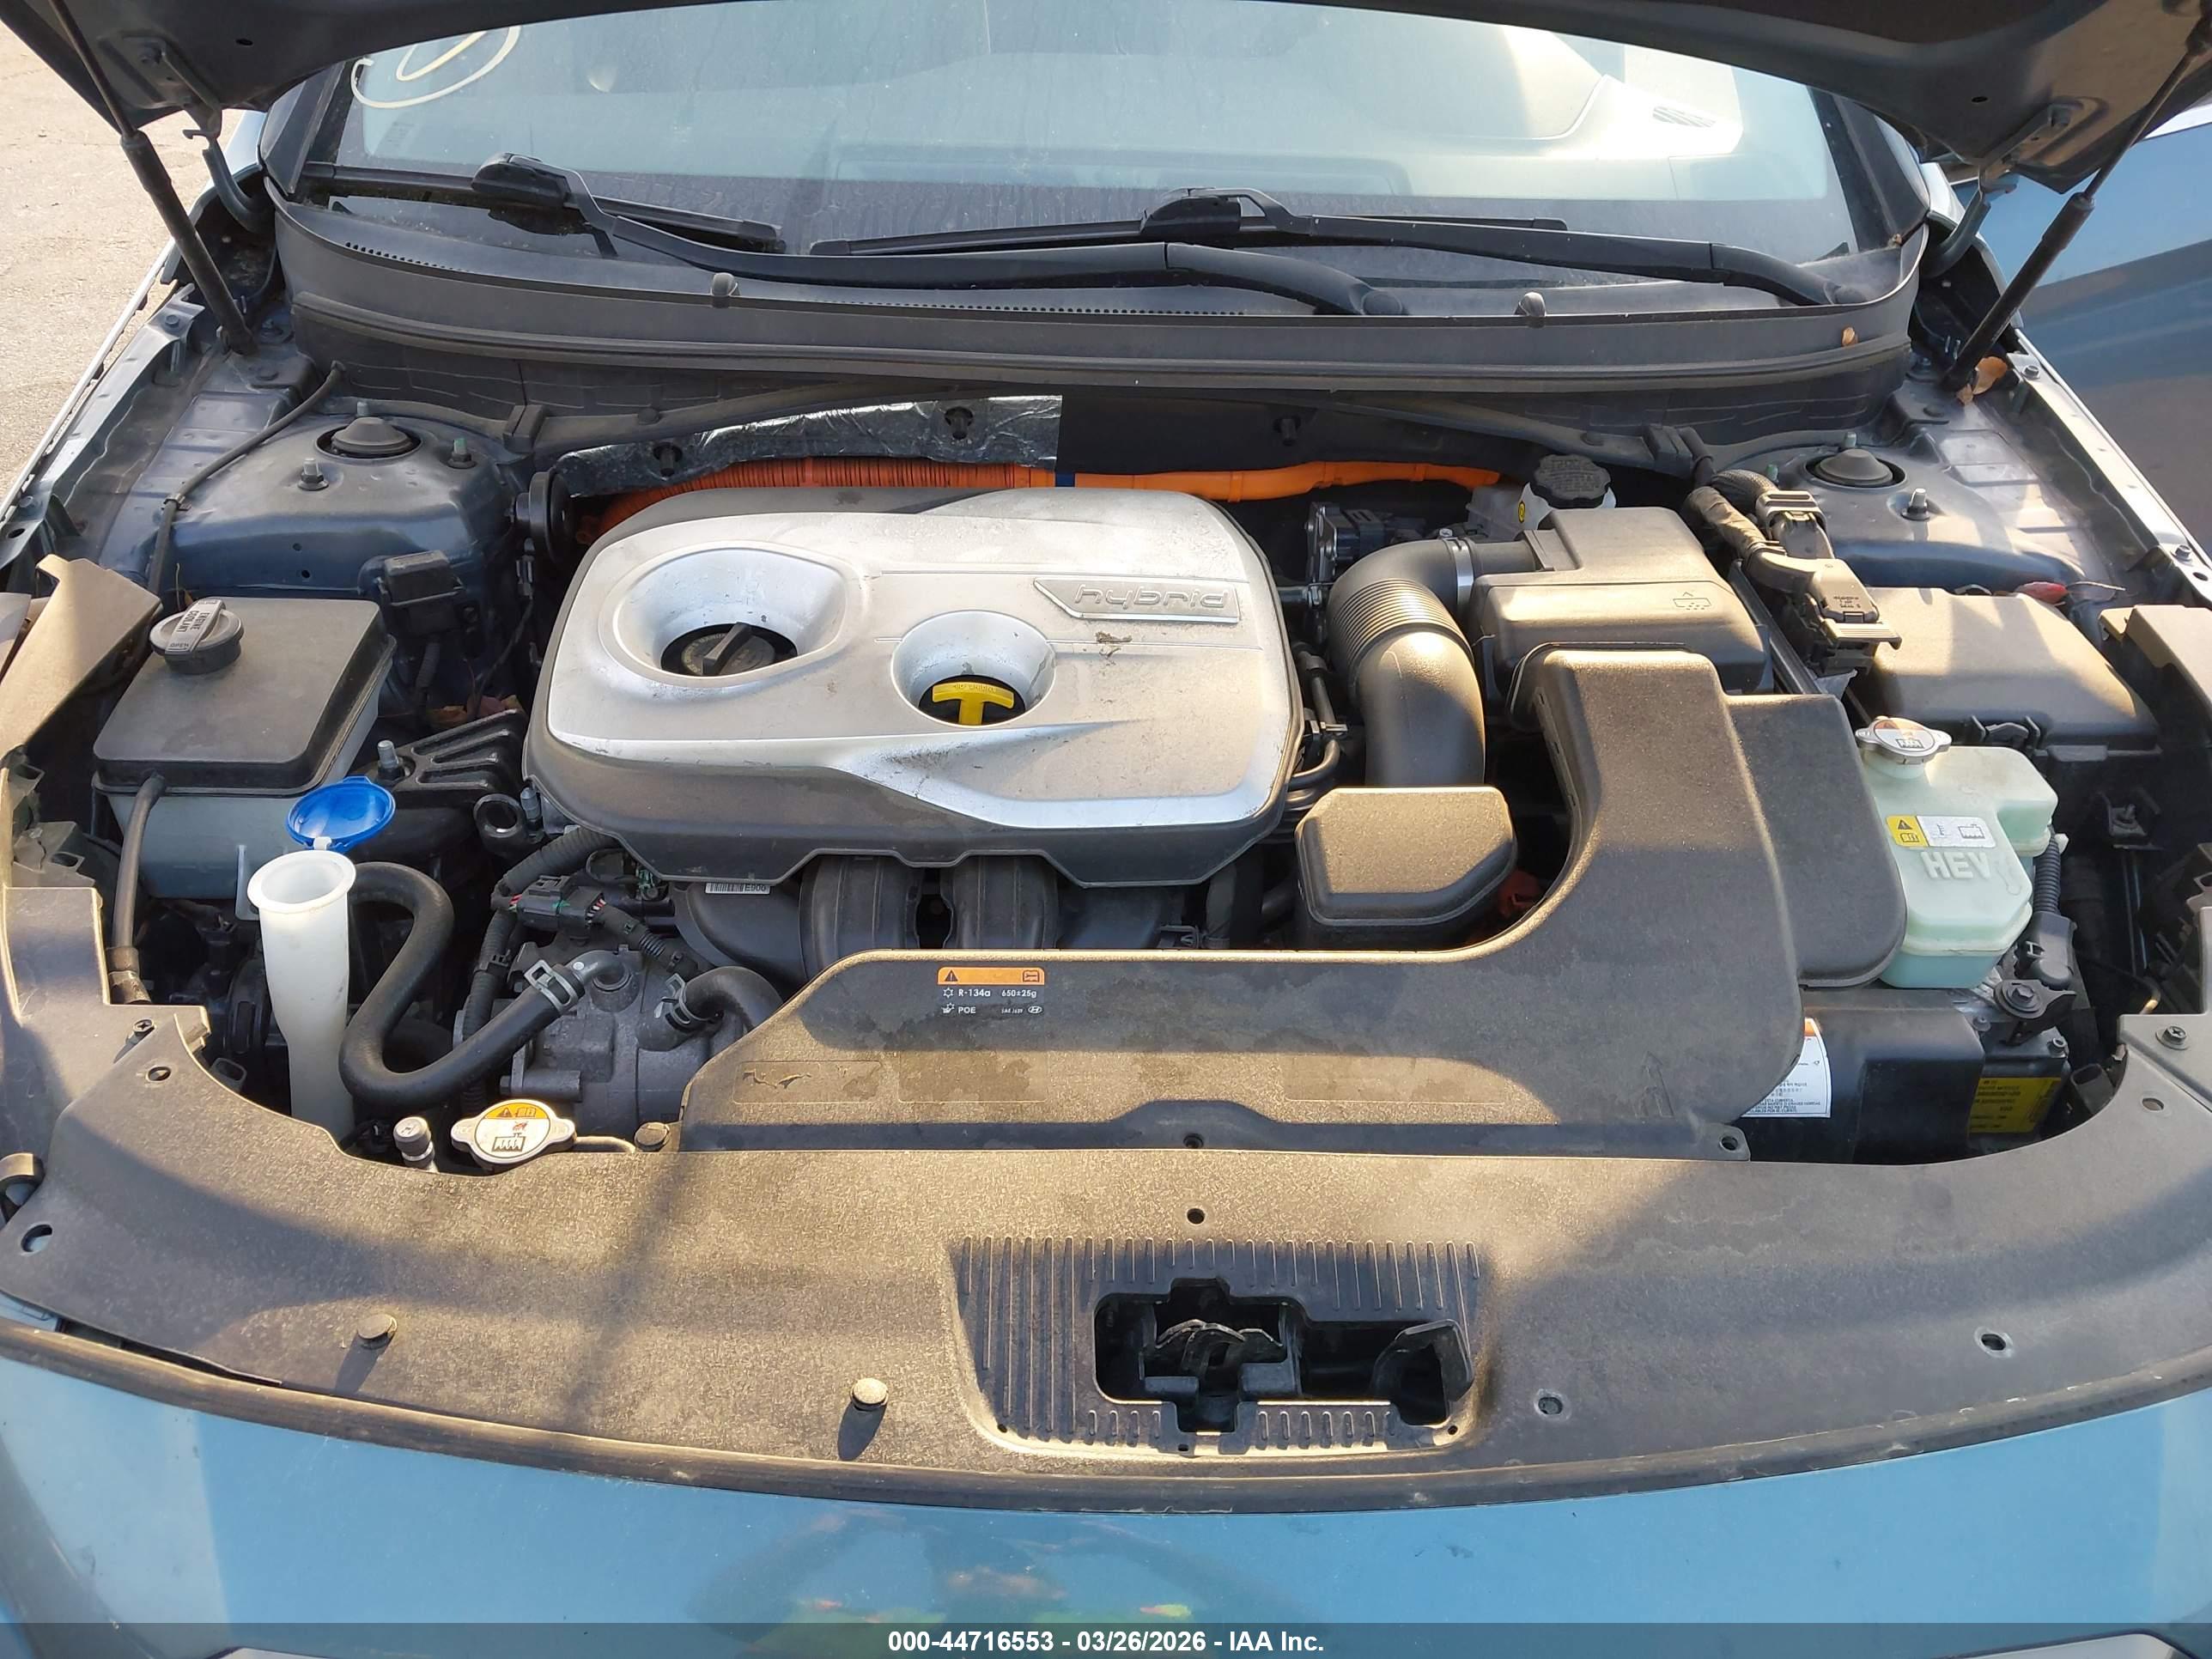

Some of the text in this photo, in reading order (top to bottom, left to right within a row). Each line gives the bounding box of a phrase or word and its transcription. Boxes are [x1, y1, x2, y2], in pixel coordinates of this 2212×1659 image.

[1074, 584, 1229, 610] hybrid
[1920, 851, 1991, 880] HEV
[958, 988, 1037, 999] R-134a 650±25g
